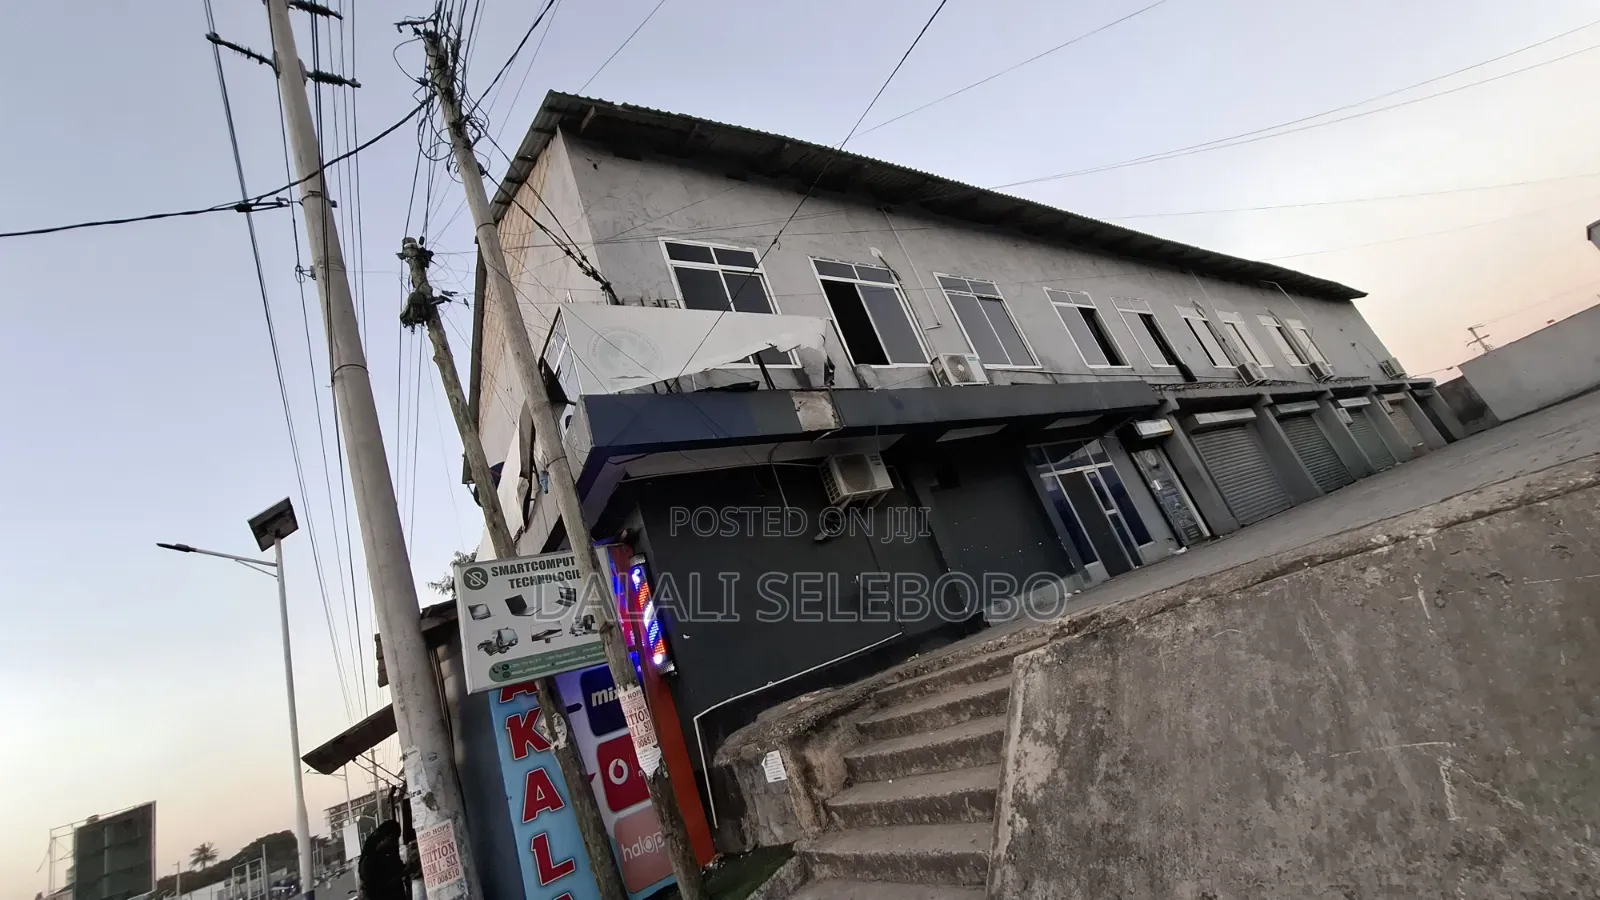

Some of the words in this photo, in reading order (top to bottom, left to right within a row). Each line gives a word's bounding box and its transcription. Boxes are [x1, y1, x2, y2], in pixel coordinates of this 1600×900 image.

[490, 556, 576, 577] SMARTCOMPUT
[508, 569, 582, 589] TECHNOLOGIE
[591, 686, 619, 707] mix
[621, 831, 665, 862] halop
